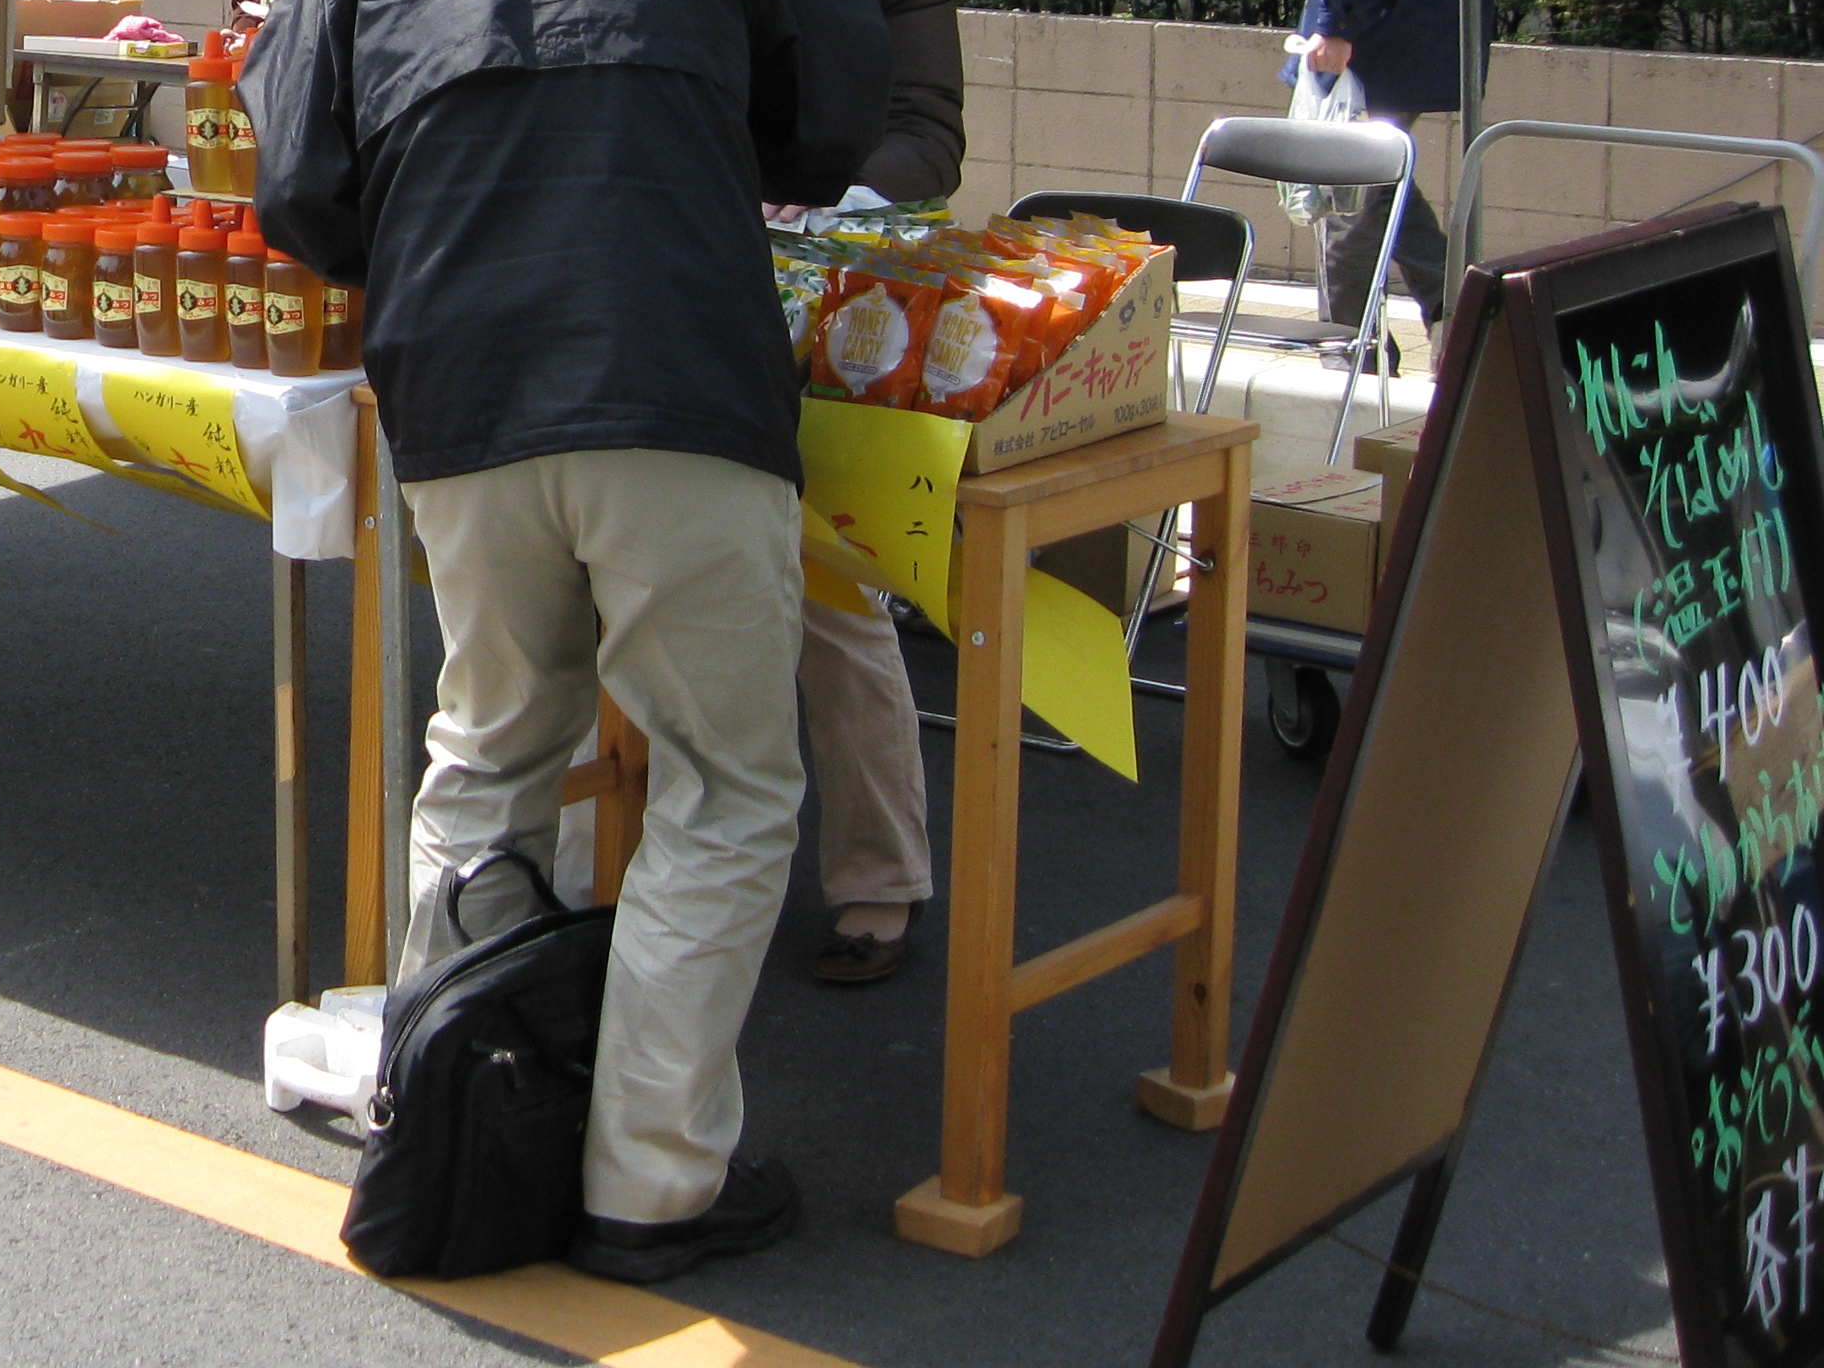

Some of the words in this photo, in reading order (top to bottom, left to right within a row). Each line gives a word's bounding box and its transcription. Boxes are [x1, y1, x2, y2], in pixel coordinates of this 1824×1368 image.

[847, 305, 892, 338] HONEY
[933, 310, 983, 348] HONEY
[841, 334, 886, 364] CANDY
[133, 391, 200, 417] ハンガリー産
[993, 432, 1035, 456] 株式会社
[1691, 903, 1817, 1056] ¥300
